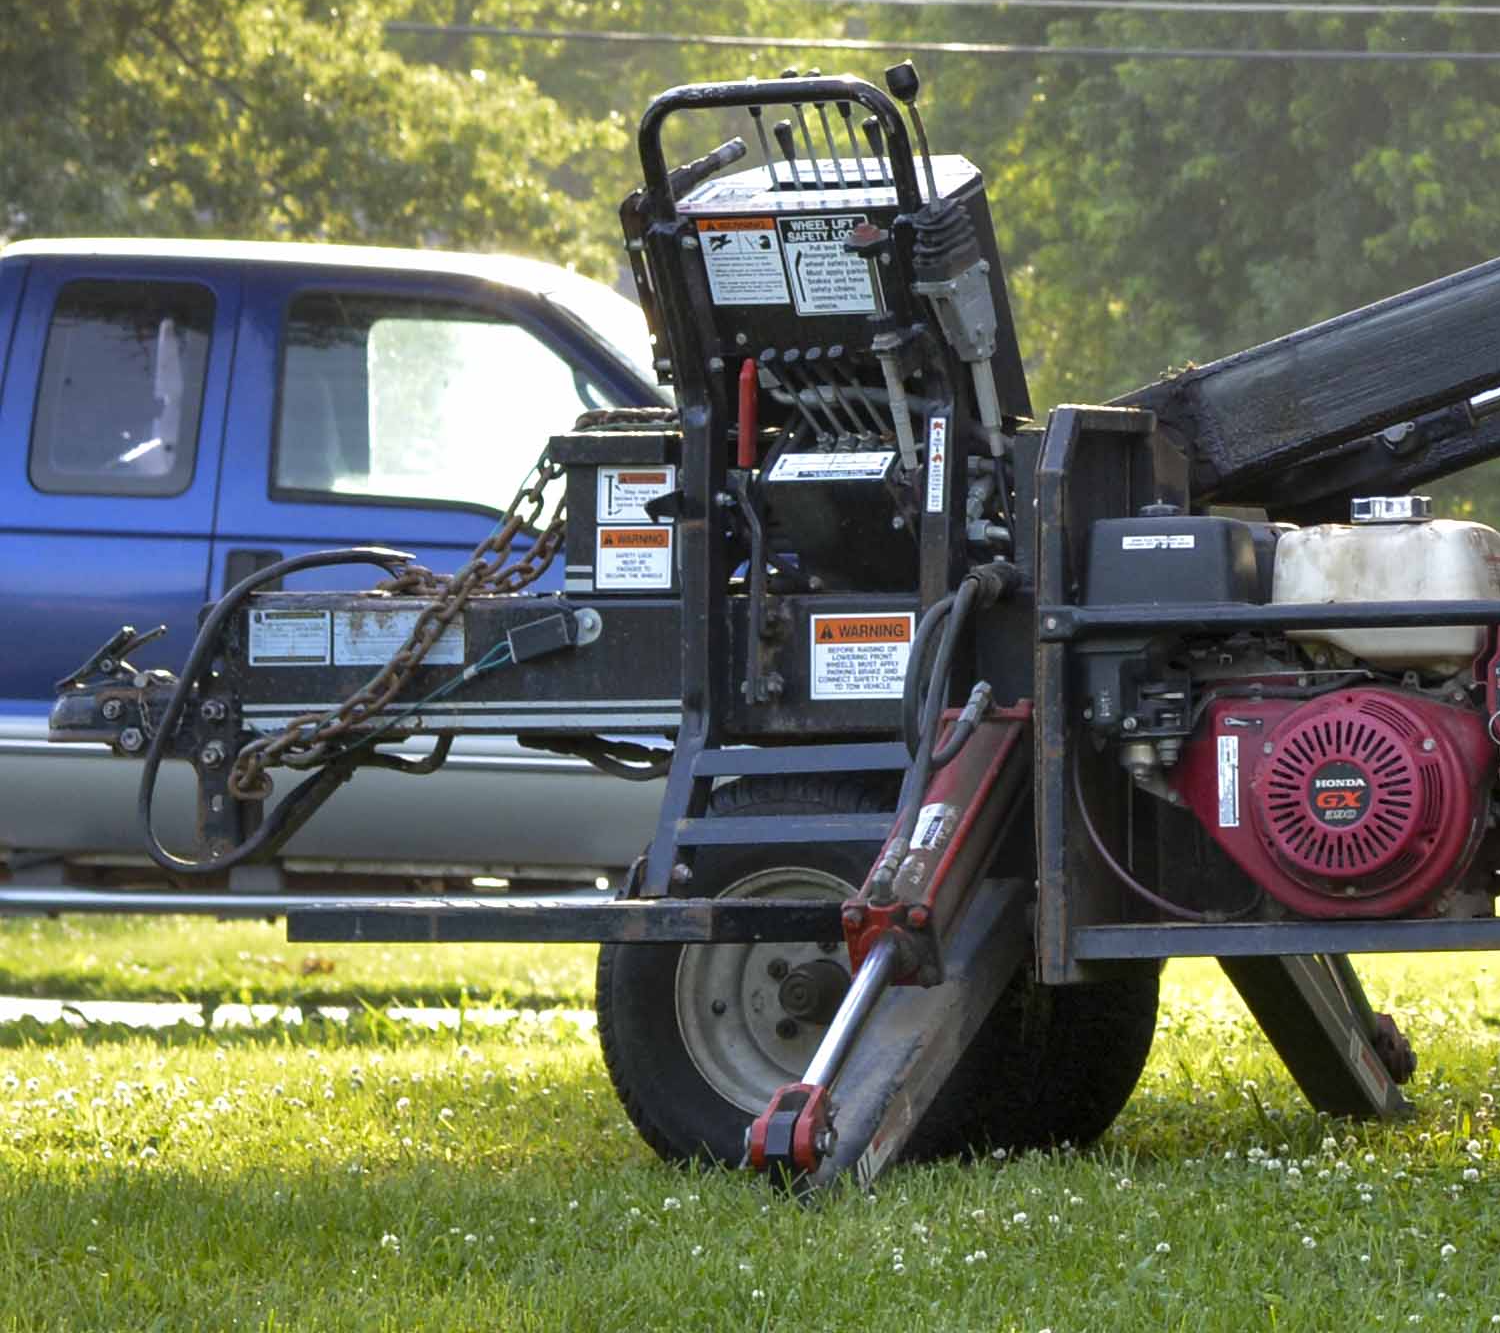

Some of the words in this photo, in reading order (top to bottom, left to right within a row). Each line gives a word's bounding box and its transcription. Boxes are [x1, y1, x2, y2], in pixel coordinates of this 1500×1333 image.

[790, 220, 827, 230] WHEEL
[831, 219, 854, 229] LIFT
[787, 232, 828, 242] SAFETY
[832, 230, 856, 240] LOC
[618, 534, 664, 546] WARNING
[839, 624, 904, 638] WARNING
[1315, 778, 1367, 788] HONDA
[1316, 791, 1363, 809] GX
